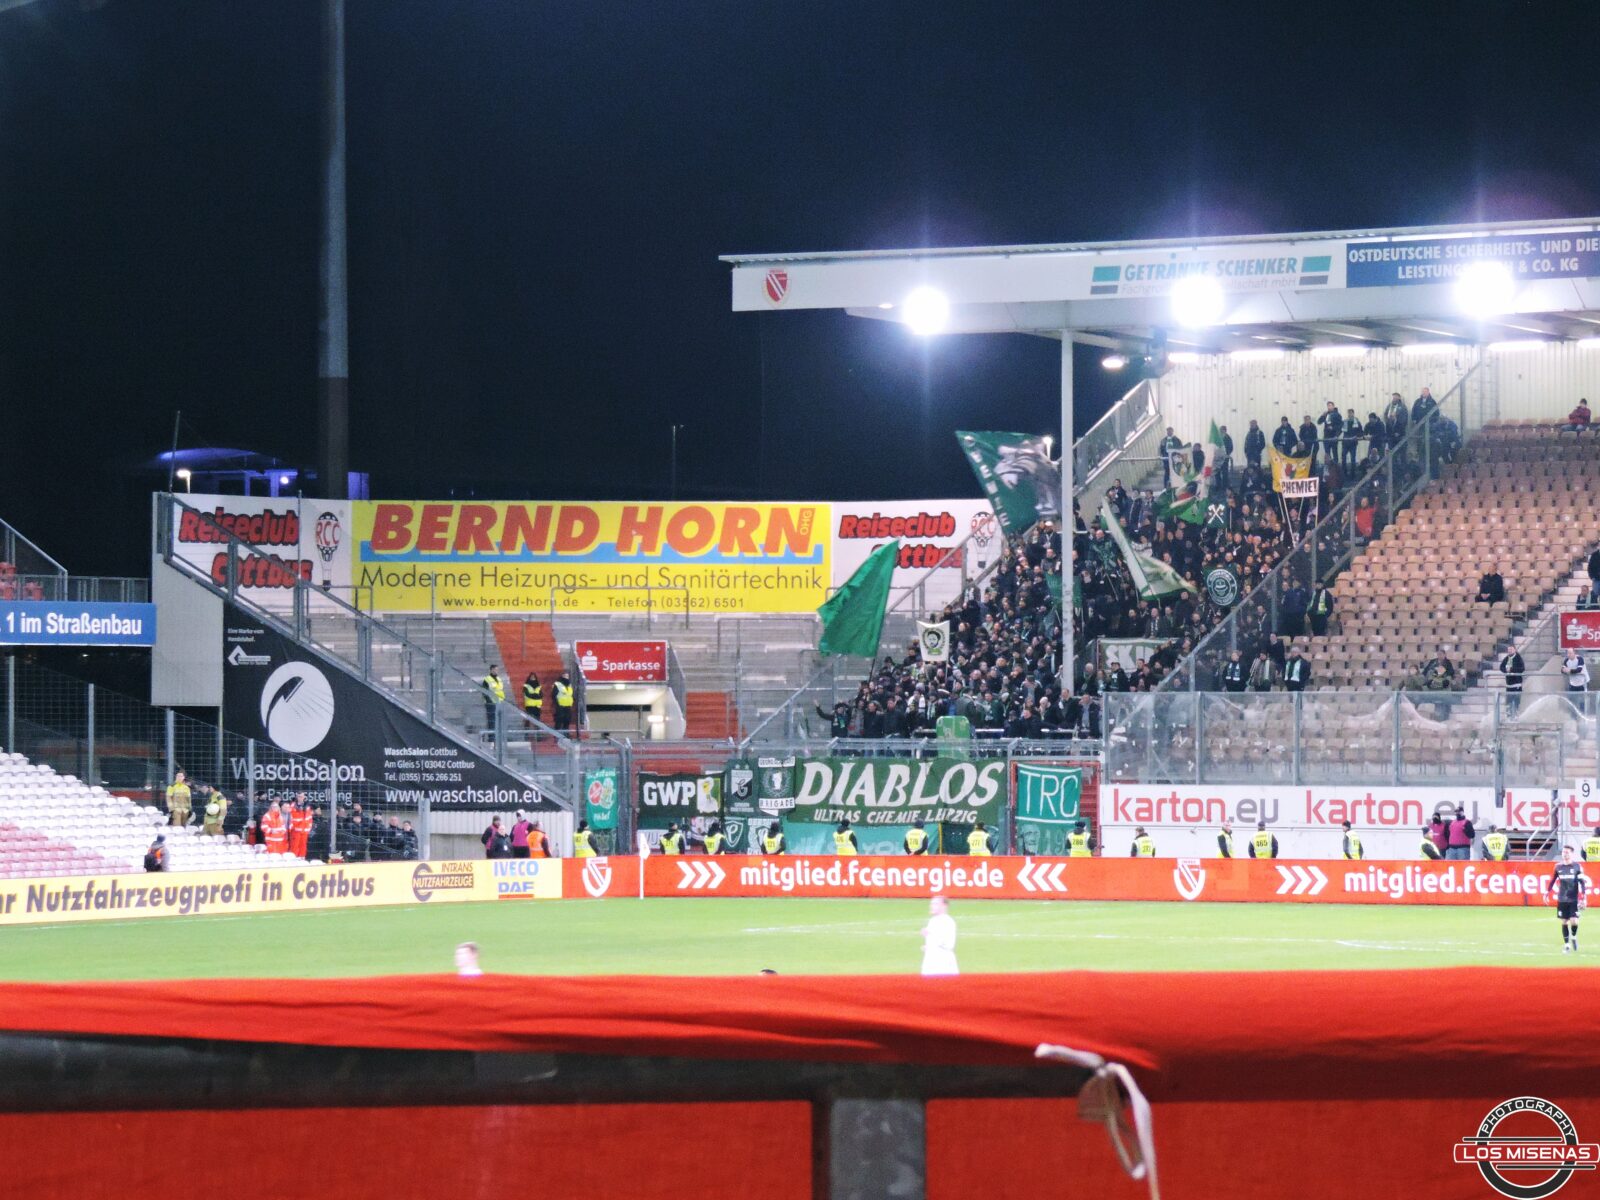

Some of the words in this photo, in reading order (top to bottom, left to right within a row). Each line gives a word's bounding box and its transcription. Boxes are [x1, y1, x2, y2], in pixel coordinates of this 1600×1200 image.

[1349, 246, 1441, 262] OSTDEUTSCHE
[1445, 242, 1536, 258] SICHERHEITS-
[1541, 240, 1571, 254] UND
[1216, 257, 1298, 276] SCHENKER
[1519, 261, 1528, 273] &
[1532, 259, 1555, 273] CO.
[1560, 257, 1579, 271] KG
[1281, 480, 1317, 495] CHEMIE!
[178, 507, 299, 546] Reiseclub
[315, 521, 342, 546] RCC
[370, 504, 600, 553] BERND
[615, 506, 817, 555] HORN
[800, 510, 813, 535] OHG
[838, 512, 956, 538] Reiseclub
[211, 552, 313, 589] Cttbus
[360, 564, 471, 588] Moderne
[480, 565, 598, 594] Heizungs-
[606, 566, 649, 589] und
[658, 567, 823, 589] Sanitärtechnik
[443, 596, 579, 608] www.bernd-horn.de
[608, 597, 657, 608] Telefon
[714, 598, 744, 608] 6501
[6, 611, 15, 633] 1
[21, 612, 42, 633] im
[46, 612, 142, 635] Straßenbau
[602, 660, 660, 673] Sparkasse
[429, 748, 458, 756] Cottbus
[230, 758, 366, 781] WaschSalon
[397, 760, 415, 768] Gleis
[425, 760, 446, 768] 03042
[447, 760, 475, 768] Cottbus
[384, 773, 398, 781] Tel.
[422, 773, 434, 782] 756
[796, 762, 1004, 806] DIABLOS
[385, 785, 542, 803] www.waschsalon.eu
[643, 781, 696, 806] GWP
[1018, 770, 1078, 818] TRC
[1581, 783, 1591, 798] 9
[813, 809, 861, 823] ULTRAS
[866, 811, 919, 824] CHEMIE
[1113, 788, 1279, 824] karton.eu
[441, 862, 473, 873] INTRANS
[494, 861, 539, 876] IVECO
[740, 860, 1004, 891] mitglied.fcenergie.de
[413, 875, 473, 888] NUTZFAHRZEUGE
[498, 881, 535, 893] DAF
[26, 874, 252, 915] Nutzfahrzeugprofi
[261, 873, 282, 901] in
[292, 871, 374, 899] Cottbus
